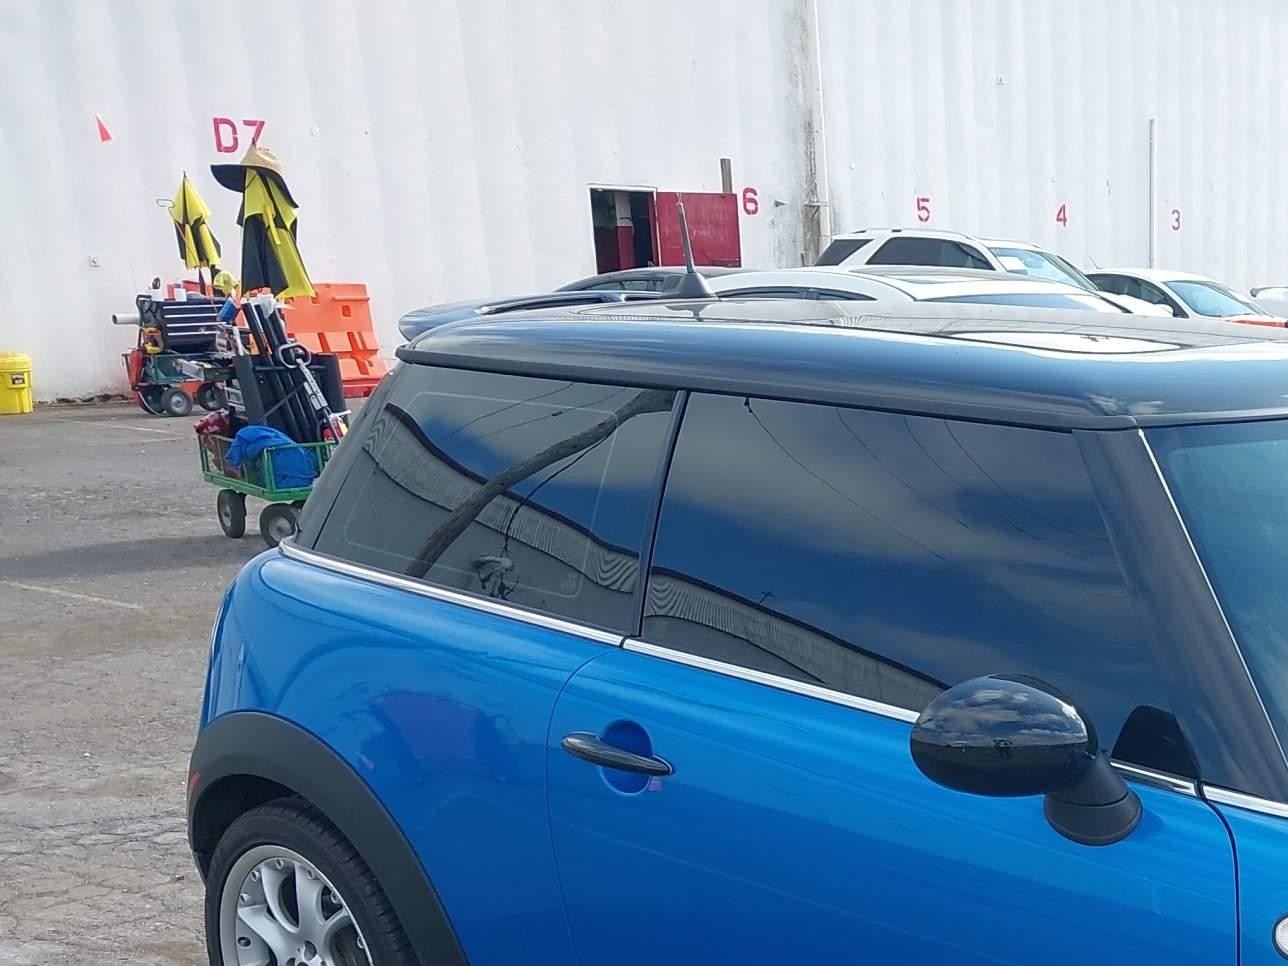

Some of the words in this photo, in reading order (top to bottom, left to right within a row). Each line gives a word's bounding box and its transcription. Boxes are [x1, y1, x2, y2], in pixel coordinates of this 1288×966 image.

[742, 187, 759, 215] 6
[917, 197, 930, 222] 5
[1055, 204, 1068, 230] 4
[1171, 208, 1182, 232] 3
